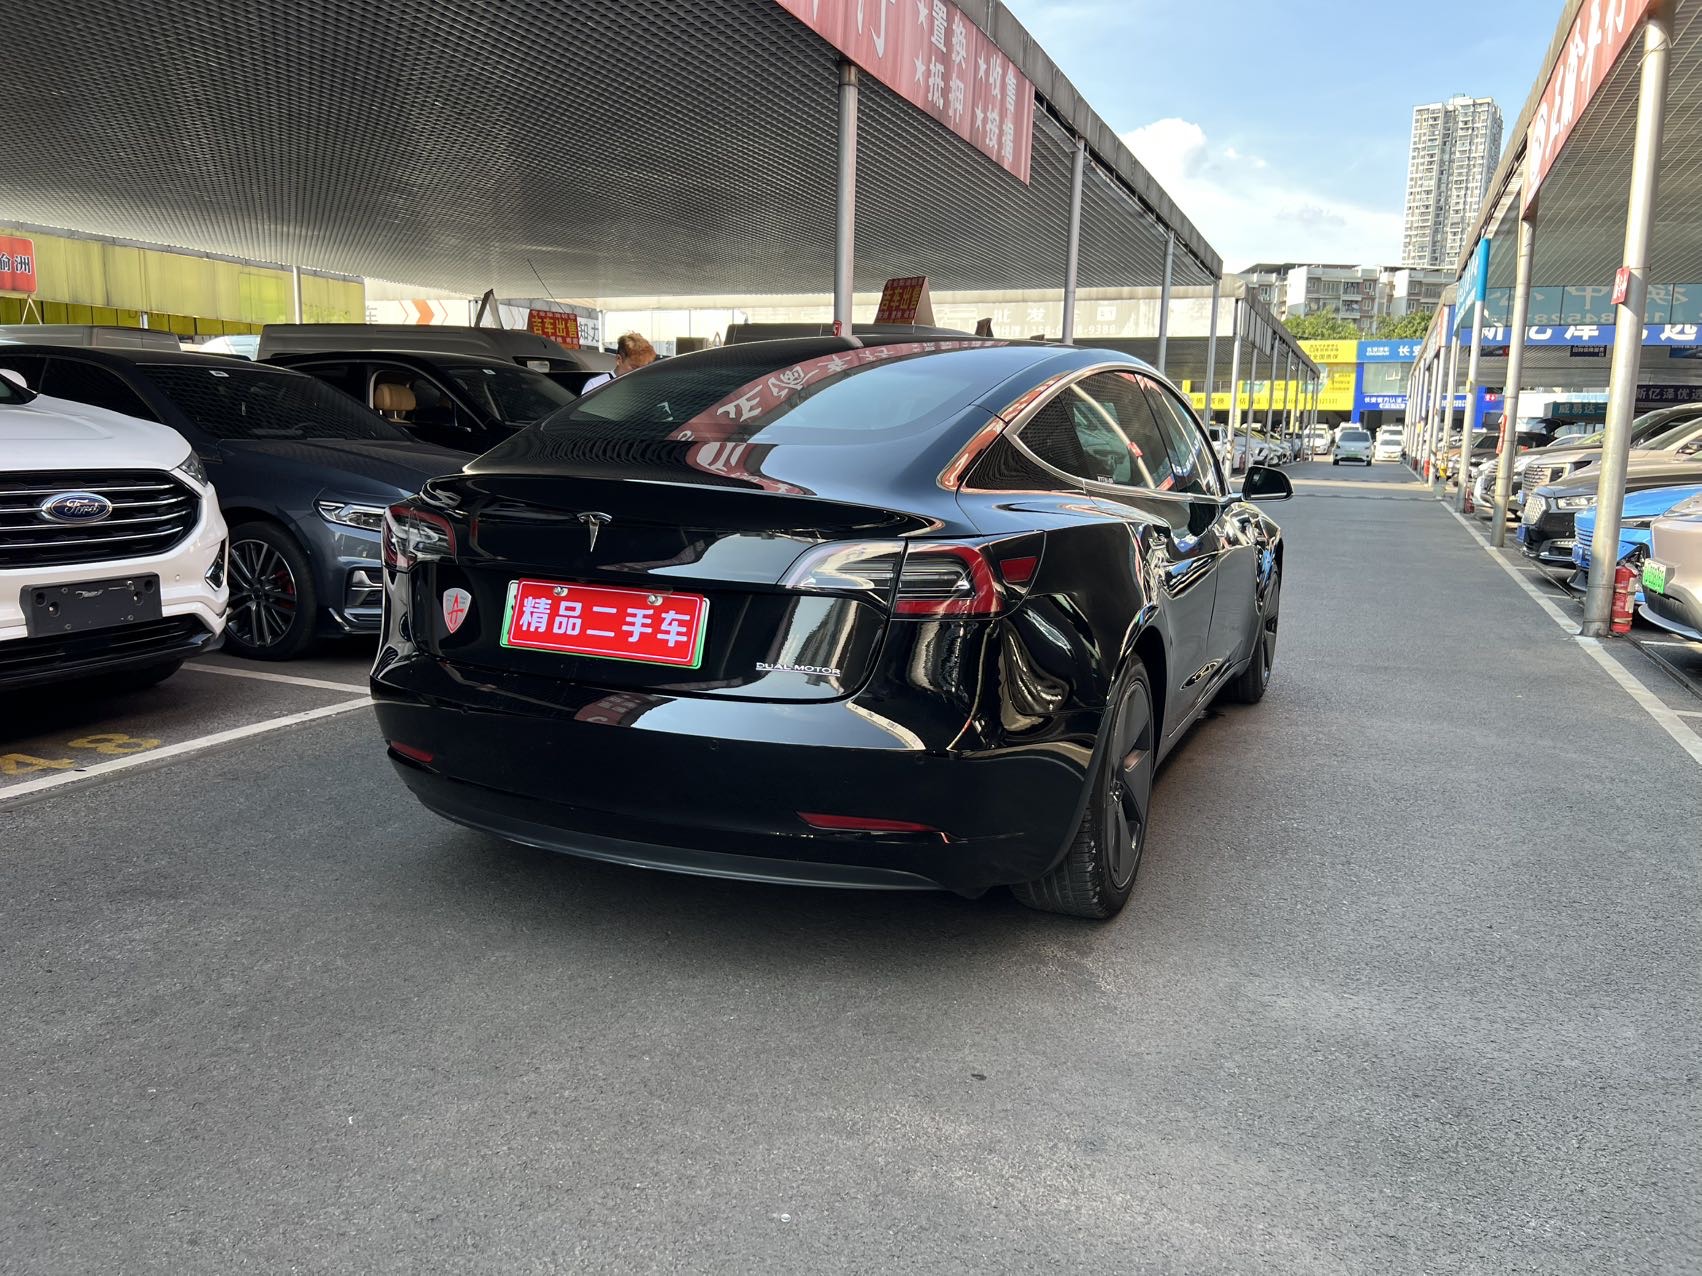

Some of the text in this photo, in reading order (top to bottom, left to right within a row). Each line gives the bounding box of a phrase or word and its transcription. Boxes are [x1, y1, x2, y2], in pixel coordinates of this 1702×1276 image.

[931, 0, 966, 69] 置换
[990, 55, 1017, 113] 收售
[928, 55, 1014, 162] 抵押 按揭
[65, 499, 98, 514] Ford
[519, 596, 691, 647] 精品二手车
[756, 662, 841, 674] DUAL MOTOR
